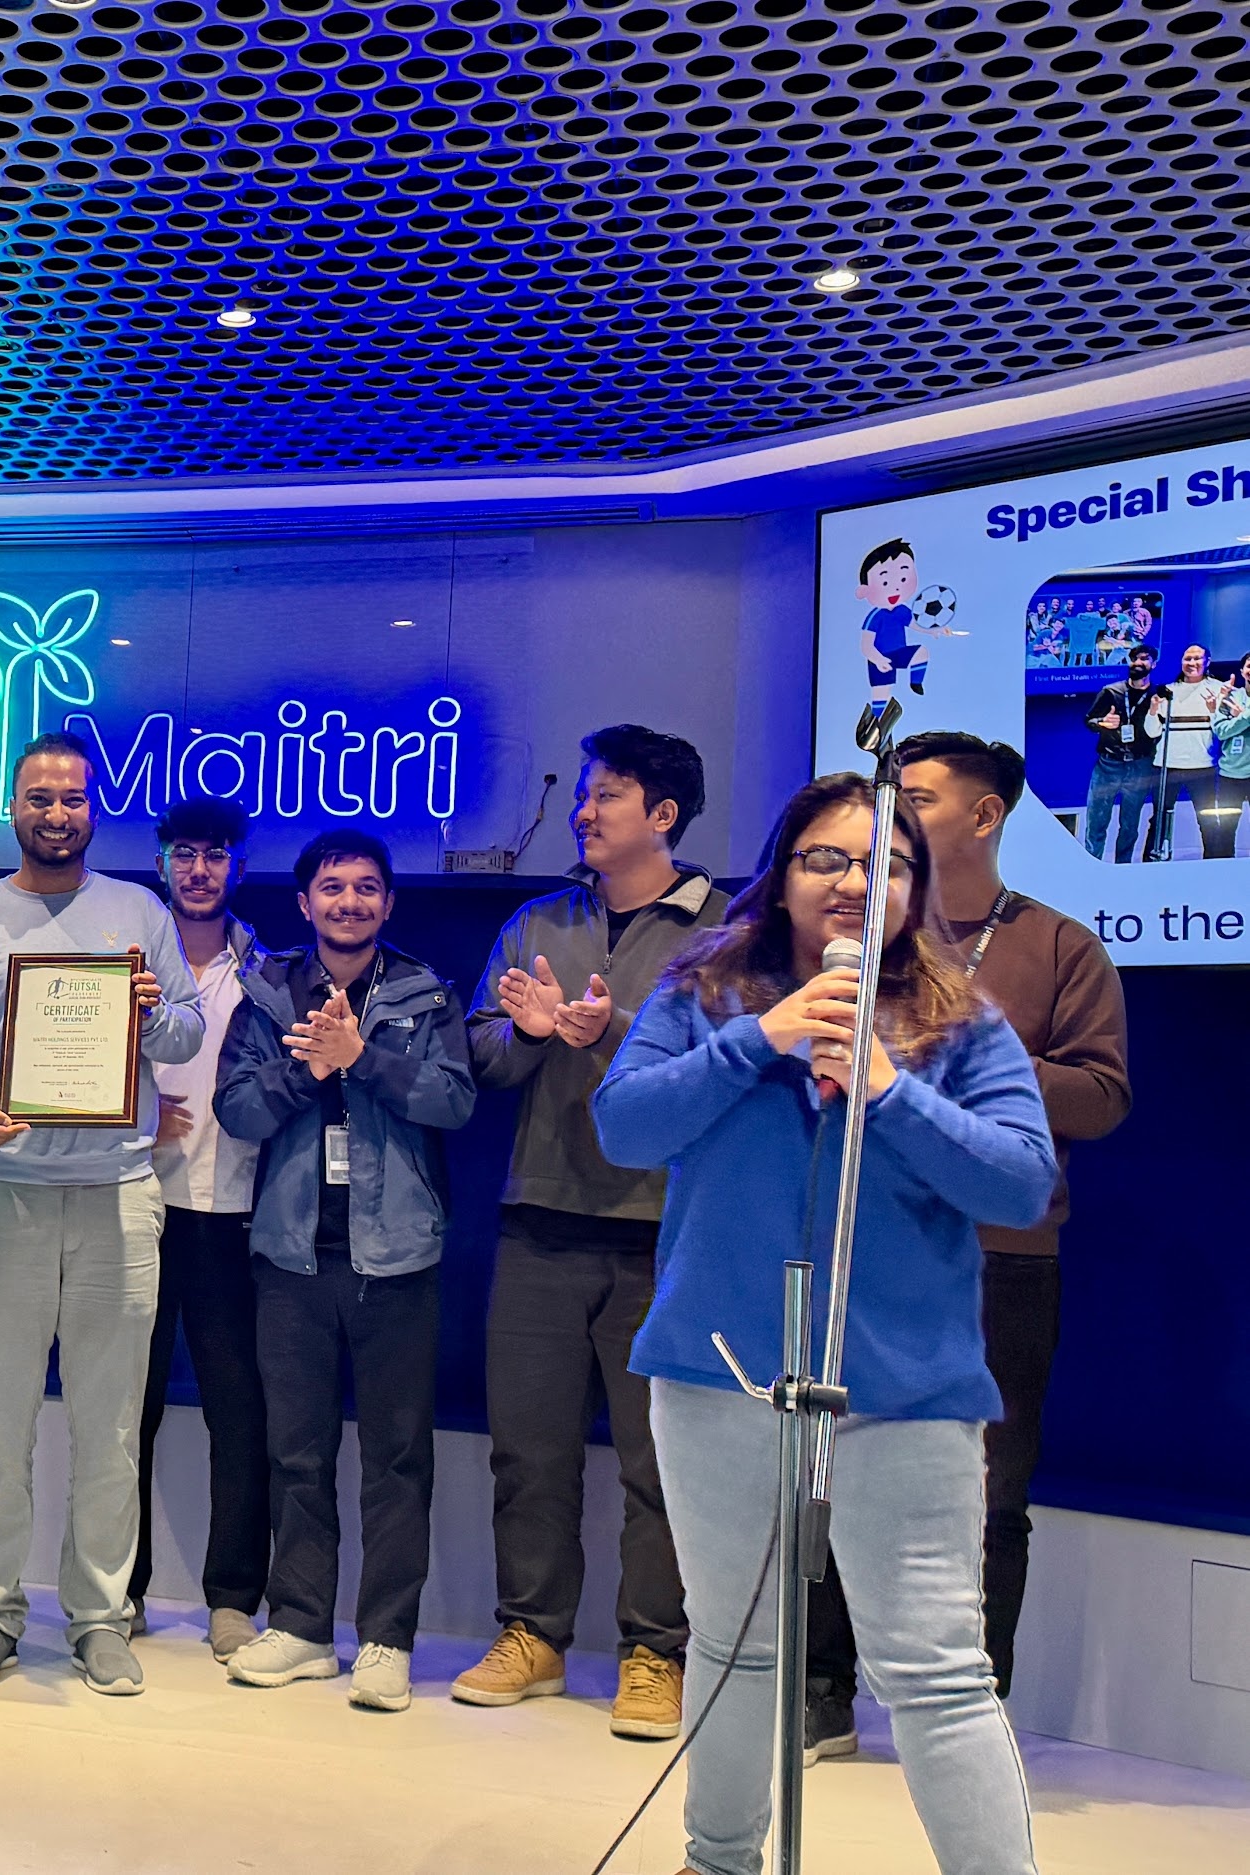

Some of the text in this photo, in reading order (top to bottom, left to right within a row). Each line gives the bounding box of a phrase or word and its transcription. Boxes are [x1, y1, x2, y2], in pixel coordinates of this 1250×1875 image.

[986, 476, 1169, 542] Special
[64, 697, 462, 819] Maitri
[975, 925, 995, 953] Maitri
[1094, 905, 1245, 943] to the
[69, 981, 102, 992] FUTSAL
[43, 1004, 101, 1016] CERTIFICATE
